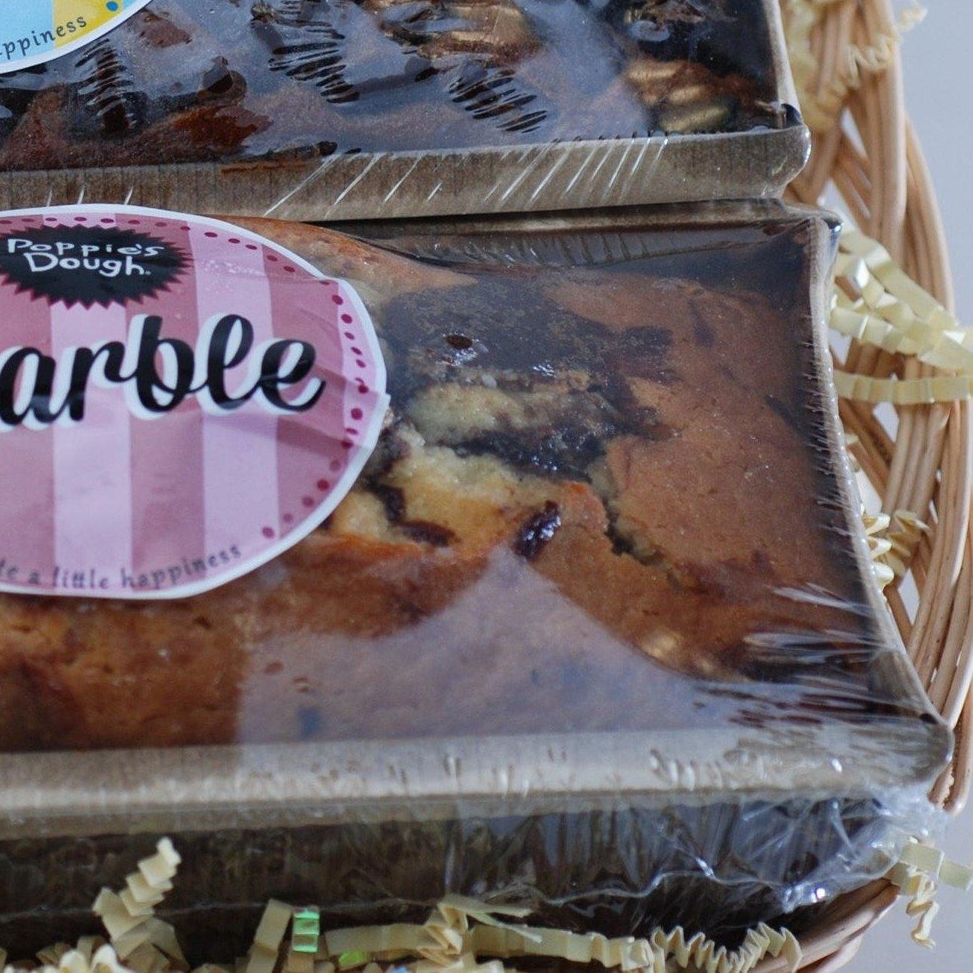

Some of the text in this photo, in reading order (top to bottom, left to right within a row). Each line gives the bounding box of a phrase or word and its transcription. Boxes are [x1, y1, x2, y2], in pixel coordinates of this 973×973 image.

[7, 238, 165, 257] Poppie's
[23, 252, 145, 277] Dough
[28, 573, 40, 585] a
[53, 566, 109, 590] little
[121, 543, 242, 590] happiness
